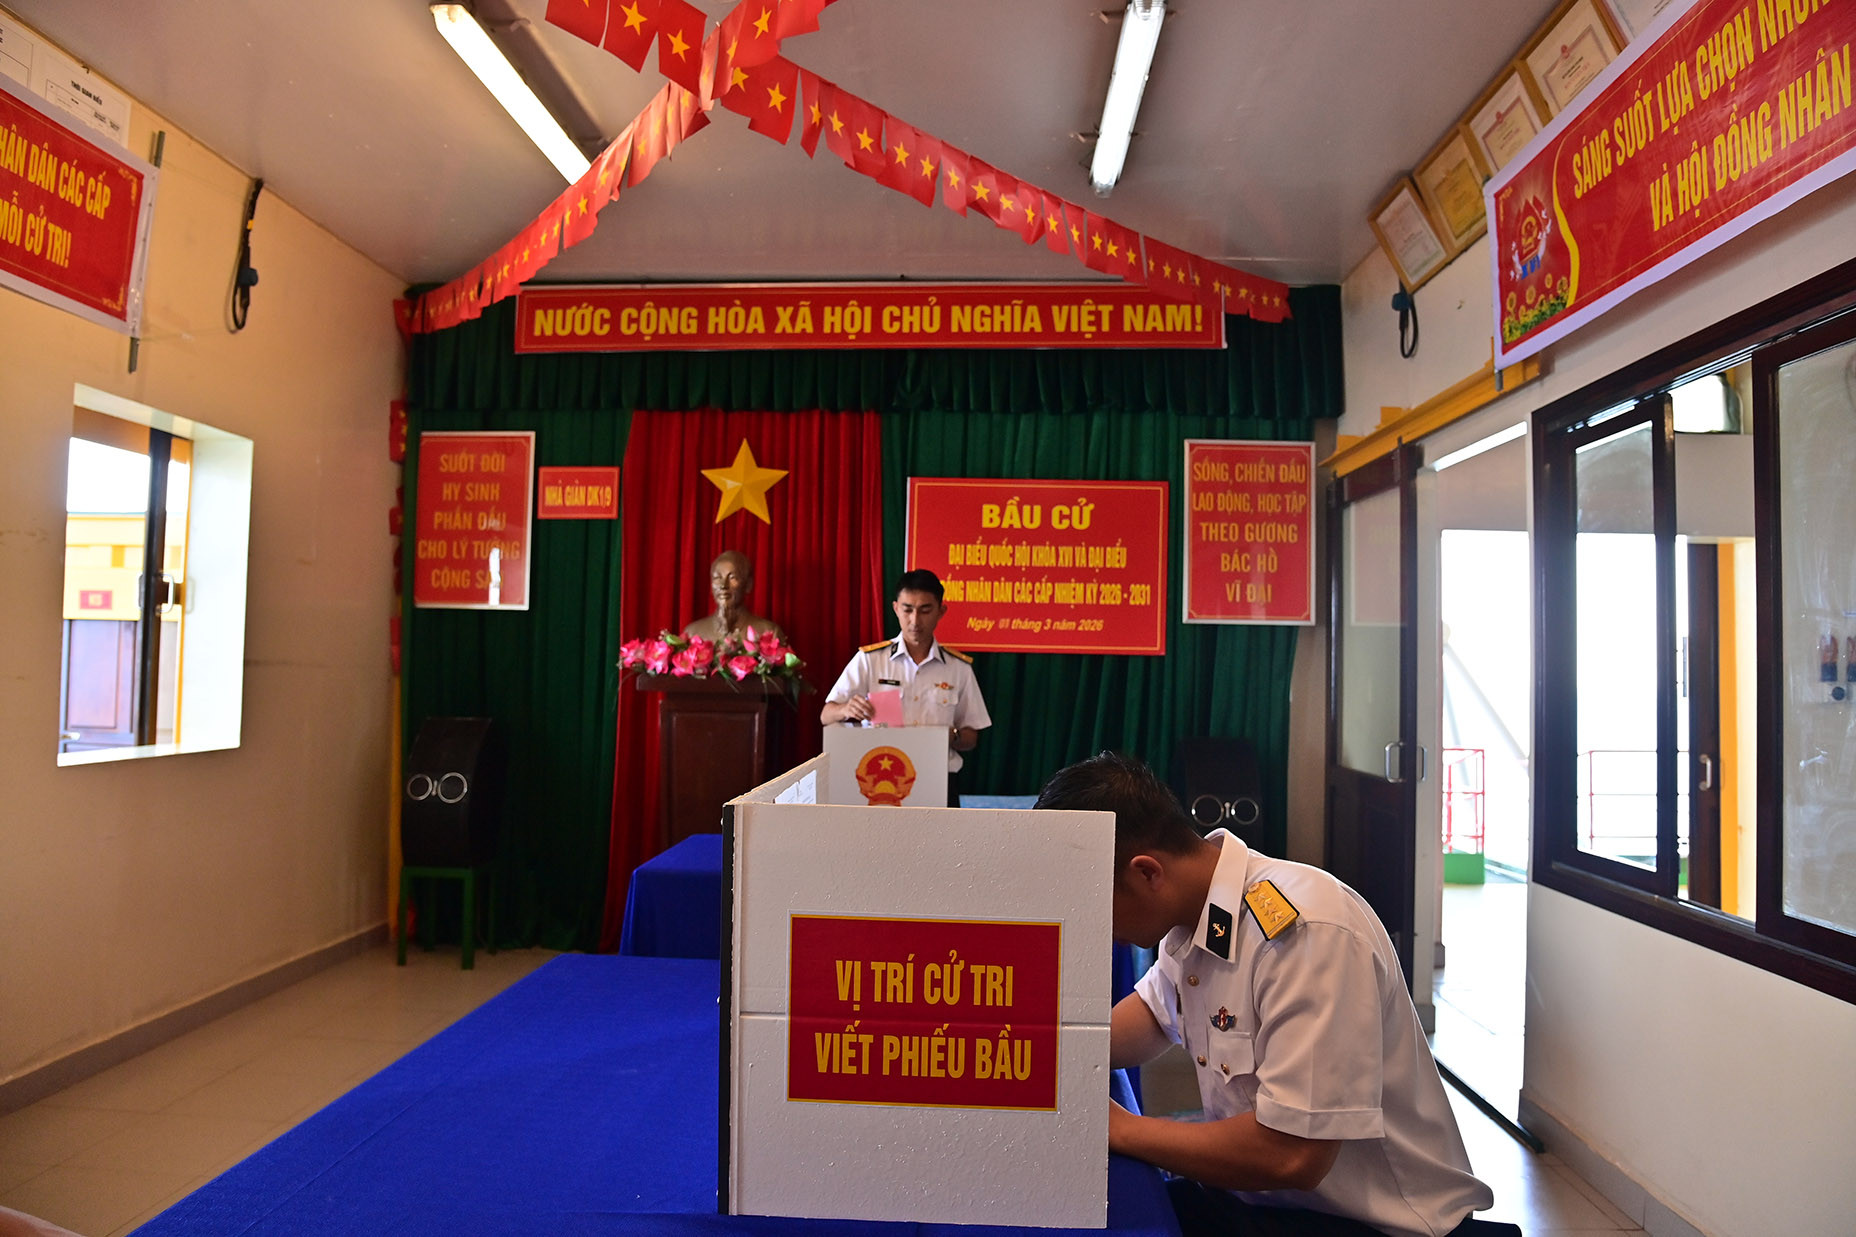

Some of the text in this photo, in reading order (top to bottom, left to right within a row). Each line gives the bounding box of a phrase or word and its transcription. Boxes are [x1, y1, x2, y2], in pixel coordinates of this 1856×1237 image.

[1572, 136, 1612, 199] SÁNG
[1613, 79, 1654, 166] SUỐT
[1657, 60, 1694, 135] LỰA
[1696, 6, 1754, 91] CHỌN
[1757, 0, 1830, 53] NH
[1650, 42, 1851, 232] VÀ HỘI ĐỒNG NHÂN
[28, 142, 58, 193] DÂN
[58, 159, 85, 207] CÁC
[86, 171, 111, 220] CẤP
[25, 204, 47, 256] CỬ
[46, 222, 72, 268] TRI!
[533, 296, 1203, 341] NƯỚC CỘNG HÒA XÃ HỘI CHỦ NGHĨA VIỆT NAM!
[440, 449, 506, 473] SUỐT ĐỜI
[1193, 456, 1306, 484] SỐNG, CHIẾN ĐẤU
[443, 483, 500, 501] HY SINH
[545, 479, 563, 507] NHÀ
[564, 479, 586, 507] GIÀN
[1192, 492, 1214, 511] LAO
[1258, 493, 1282, 516] HỌC
[1285, 491, 1306, 517] TẬP
[434, 505, 473, 530] PHẤN
[981, 496, 1095, 530] BẦU CỬ
[1200, 522, 1298, 543] THEO GƯƠNG
[418, 540, 447, 559] CHO
[452, 537, 472, 559] LÝ
[948, 543, 965, 570] ĐẠI
[966, 536, 987, 566] BIỂU
[988, 537, 1013, 569] QUỐC
[1014, 541, 1031, 571] HỘI
[1057, 546, 1074, 567] XVI
[1074, 541, 1087, 567] VÀ
[1088, 546, 1105, 573] ĐẠI
[1105, 538, 1127, 568] BIỂU
[1221, 547, 1278, 573] BÁC HỒ
[431, 567, 471, 591] CỘNG
[965, 577, 992, 602] NHÂN
[993, 577, 1013, 603] DÂN
[1014, 577, 1033, 603] CÁC
[1034, 575, 1053, 604] CẤP
[1054, 578, 1085, 609] NHIỆM
[1085, 578, 1099, 604] KỲ
[1099, 583, 1122, 605] 2026
[1129, 584, 1151, 605] 2031
[1225, 579, 1272, 606] VĨ ĐẠI
[967, 617, 995, 632] Ngày
[1011, 618, 1042, 633] tháng
[1043, 618, 1052, 630] 3
[1052, 618, 1077, 631] năm
[1077, 619, 1104, 631] 2026
[835, 949, 1014, 1011] VỊ TRÍ CỬ TRI
[814, 1020, 1032, 1081] VIẾT PHIẾU BẦU
